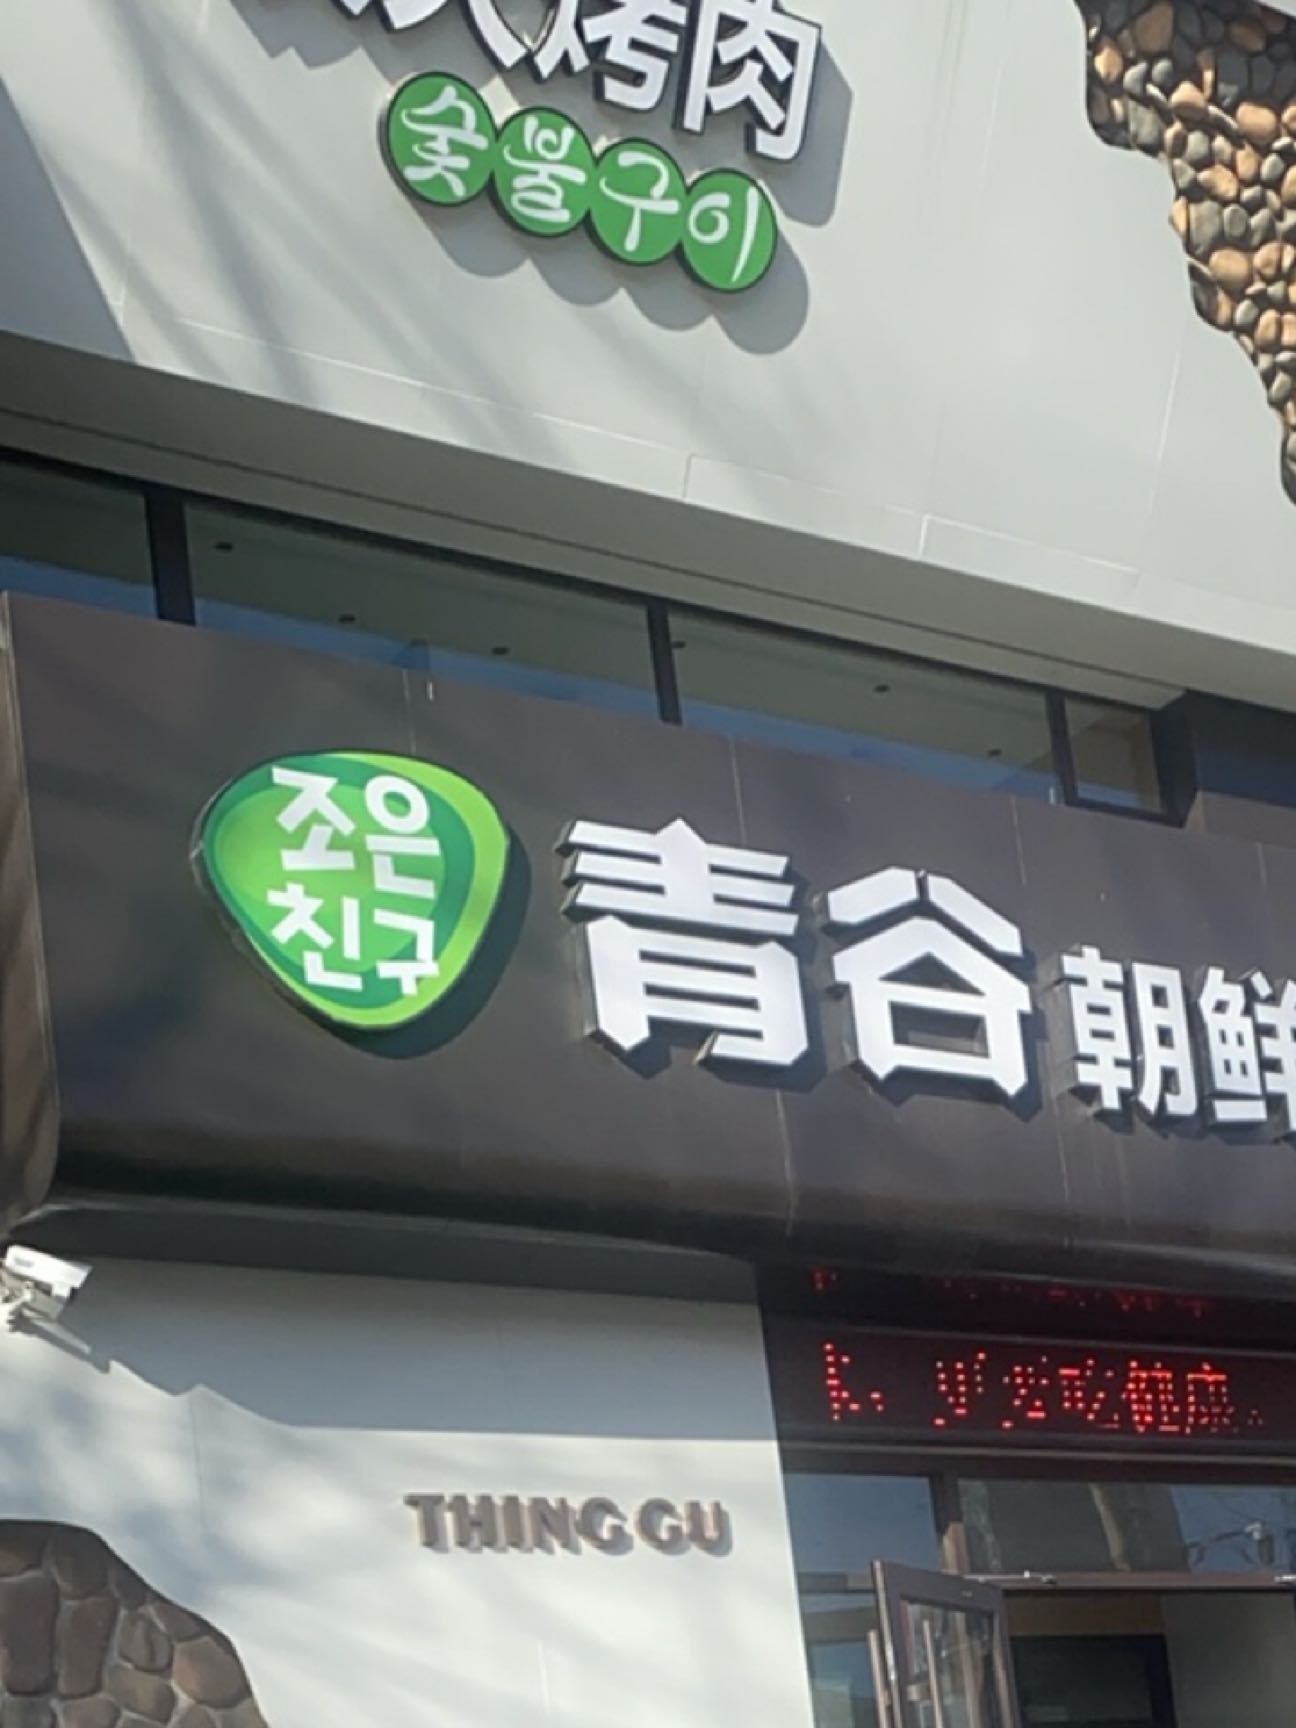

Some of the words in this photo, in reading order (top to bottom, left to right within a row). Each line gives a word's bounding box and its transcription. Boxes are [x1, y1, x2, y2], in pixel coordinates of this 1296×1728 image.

[401, 86, 762, 281] 숯불구이
[270, 765, 441, 900] 조은
[266, 883, 441, 997] 친구
[564, 817, 1032, 1098] 青谷
